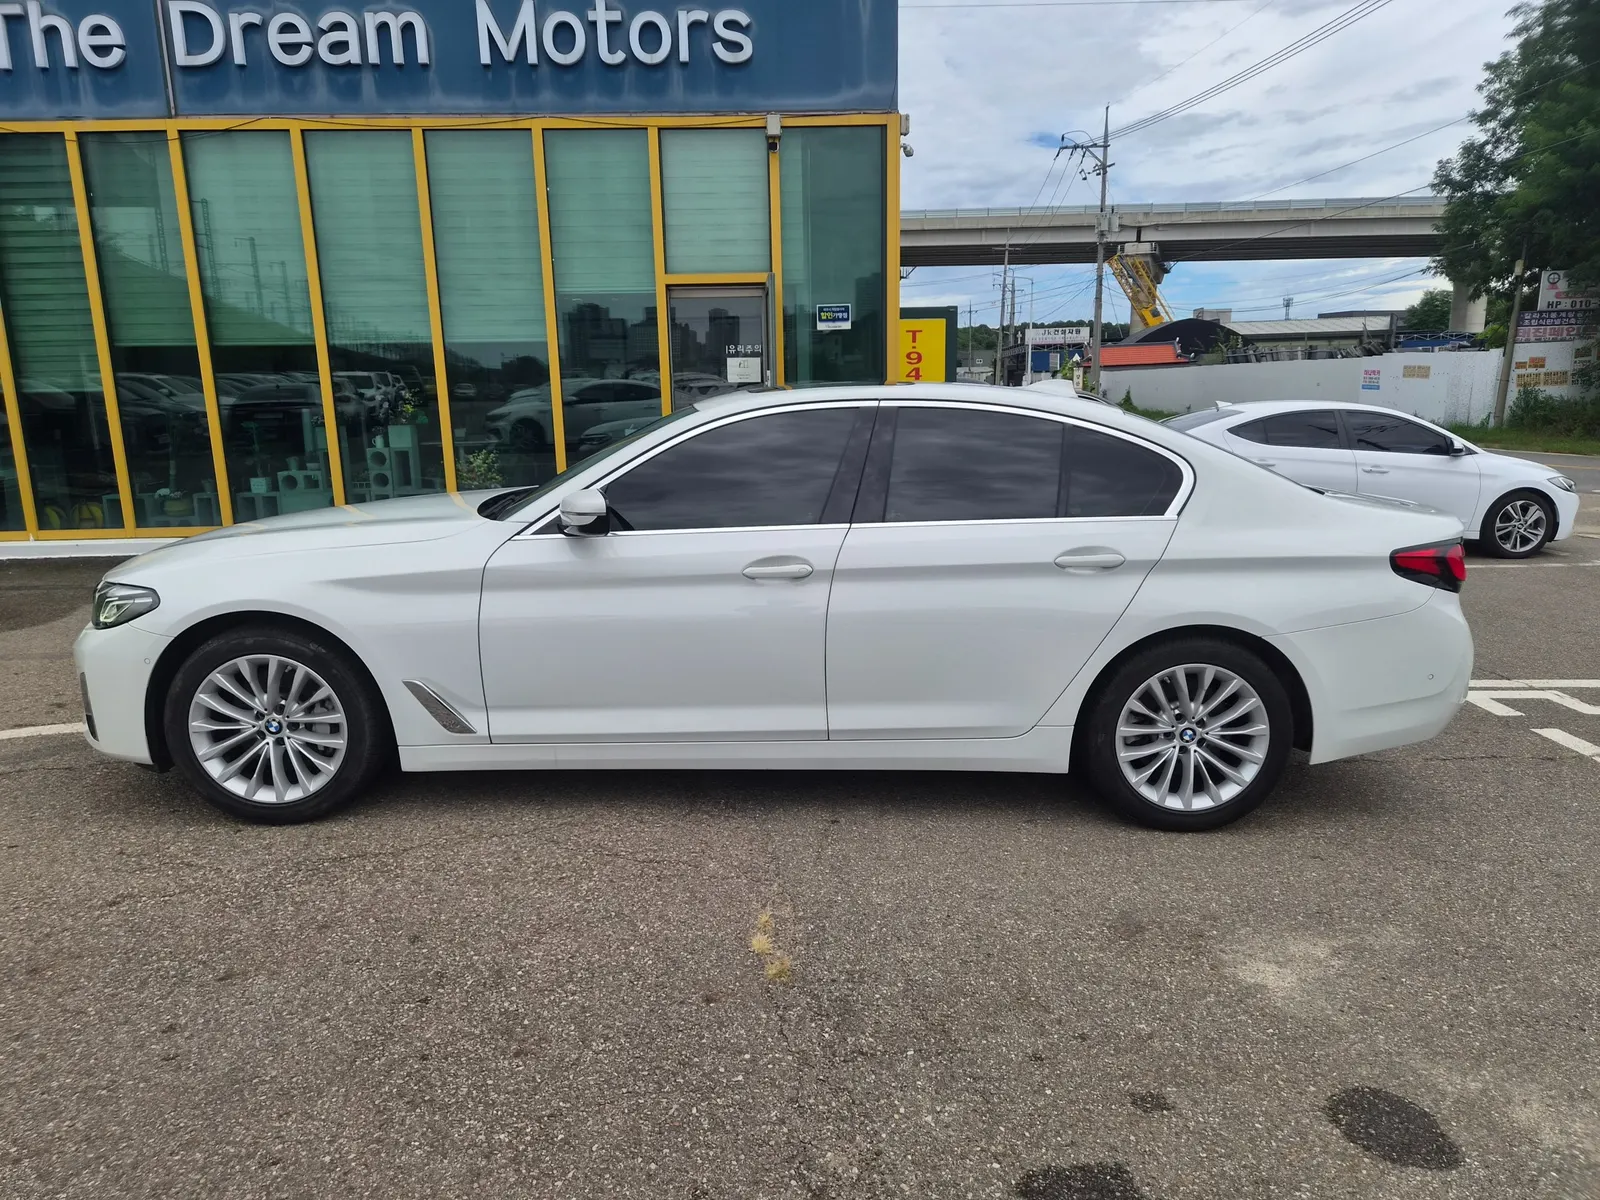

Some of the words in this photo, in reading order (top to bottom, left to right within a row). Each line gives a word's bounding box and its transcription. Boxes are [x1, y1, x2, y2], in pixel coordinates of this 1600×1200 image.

[0, 1, 126, 70] The
[170, 0, 430, 67] Dream
[477, 0, 754, 66] Motors
[1570, 300, 1600, 309] 010-
[728, 344, 762, 354] 유리주의
